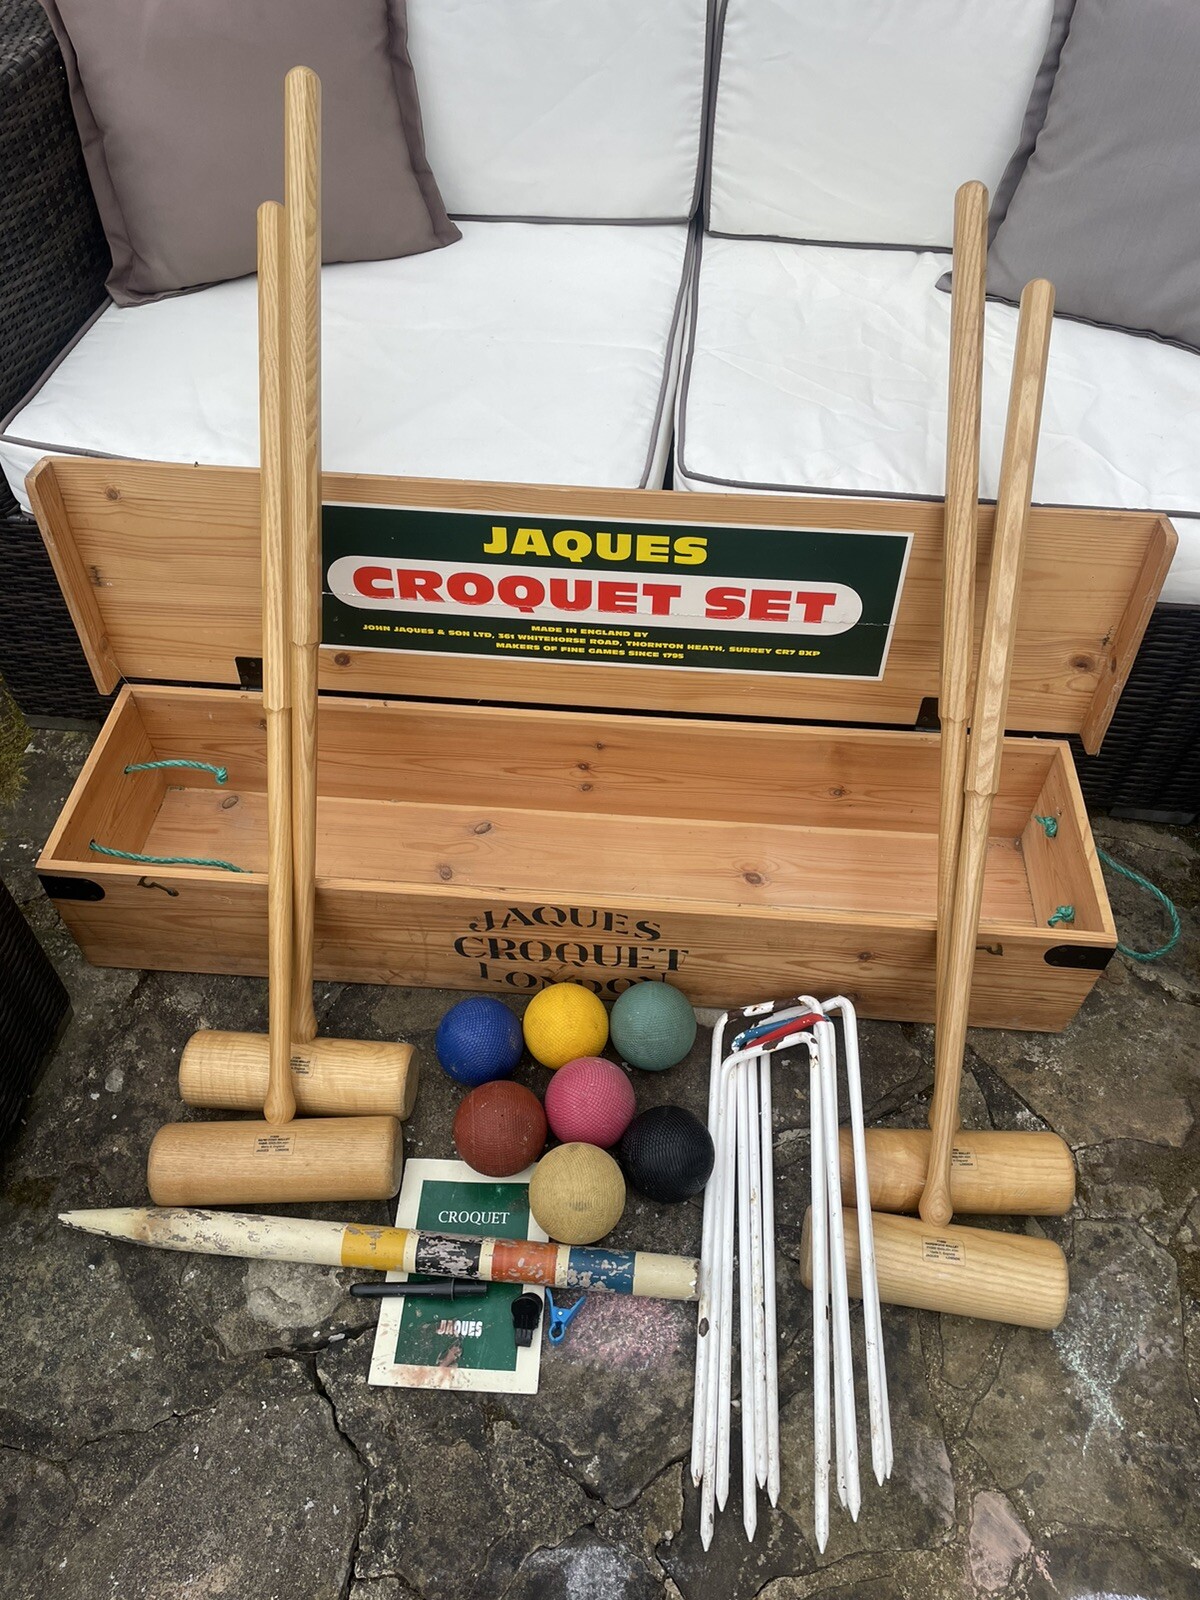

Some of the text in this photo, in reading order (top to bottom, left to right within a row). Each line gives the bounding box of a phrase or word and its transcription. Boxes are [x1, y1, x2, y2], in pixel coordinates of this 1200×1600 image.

[483, 526, 708, 566] JAQUES
[352, 566, 837, 624] CROQUET SET
[362, 624, 391, 632] JOHN
[393, 626, 434, 635] JAQUES
[473, 631, 496, 639] LTD,
[517, 633, 586, 643] WHITEHORSE
[589, 638, 623, 646] ROAD,
[625, 640, 684, 650] THORNTON
[687, 644, 726, 653] HEATH,
[729, 646, 773, 655] SURREY
[775, 648, 796, 656] CR7
[531, 625, 562, 633] MADE
[580, 628, 631, 637] ENGLAND
[495, 642, 541, 651] MAKERS
[588, 648, 626, 656] GAMES
[628, 650, 660, 658] SINCE
[662, 652, 685, 660] 1795
[468, 906, 661, 942] JAQUES
[453, 936, 690, 971] CROQUET
[437, 1210, 511, 1226] CROQUET
[437, 1319, 483, 1338] JAQUES
